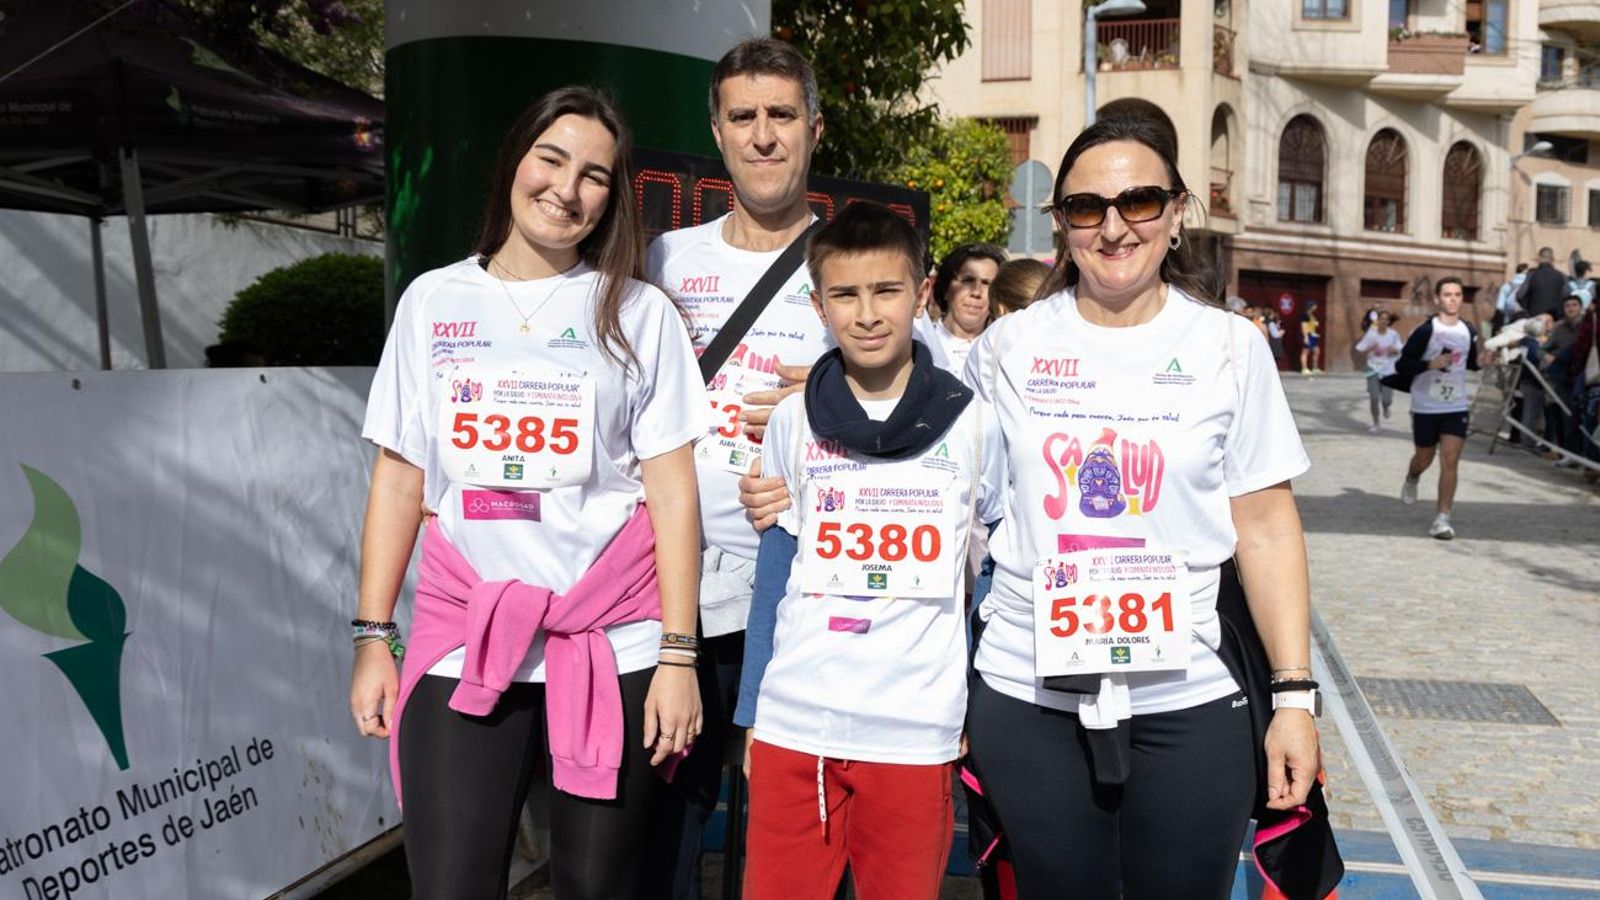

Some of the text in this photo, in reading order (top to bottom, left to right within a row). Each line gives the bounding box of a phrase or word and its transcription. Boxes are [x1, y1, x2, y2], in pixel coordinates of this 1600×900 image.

[679, 276, 721, 293] XXVII
[432, 321, 477, 338] XXVII
[1030, 356, 1080, 377] XXVII
[518, 380, 547, 391] CARRERA
[548, 382, 581, 392] POPULAR
[1027, 378, 1097, 390] CARRERA POPULAR
[451, 412, 579, 455] 5385
[719, 439, 736, 448] JUAN
[501, 454, 525, 462] ANITA
[1042, 431, 1165, 521] SALUD
[858, 487, 940, 498] XXVII CARRERA POPULAR
[815, 521, 942, 563] 5380
[861, 563, 893, 572] JOSEMA
[1114, 555, 1142, 564] CARRERA
[1143, 554, 1173, 563] POPULAR
[1050, 591, 1174, 638] 5381
[1116, 635, 1151, 645] DOLORES
[0, 737, 275, 876] atronato Municipal de
[22, 784, 259, 900] Deportes de Jaén
